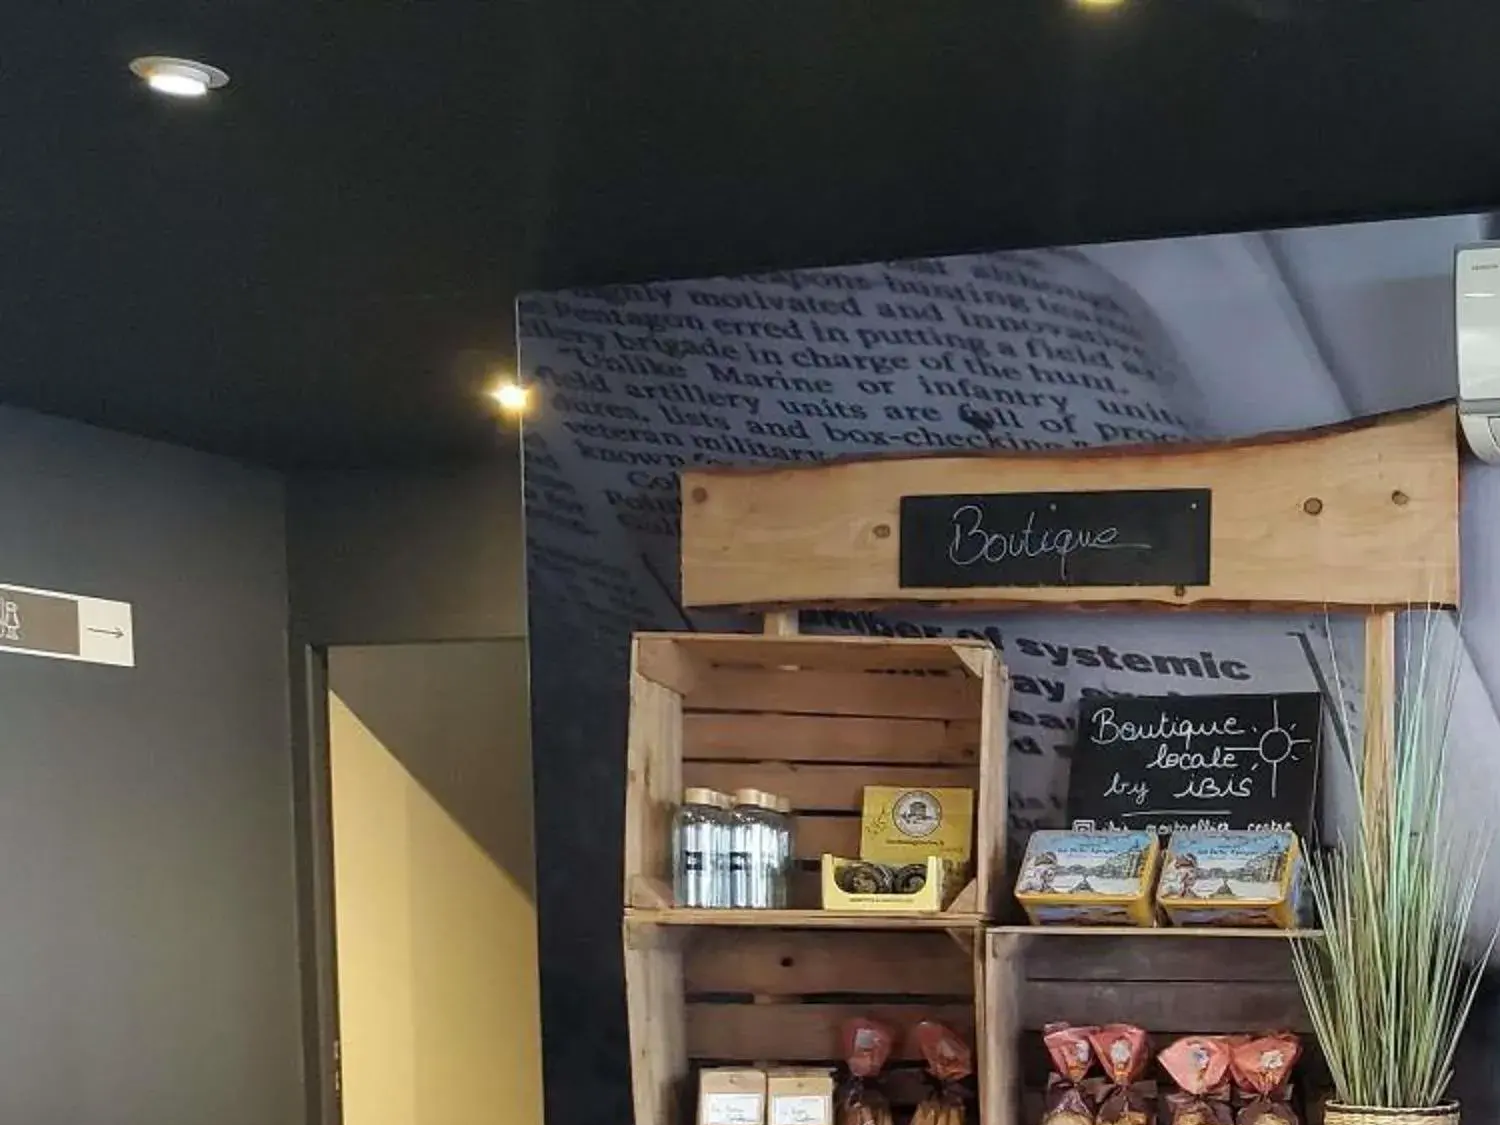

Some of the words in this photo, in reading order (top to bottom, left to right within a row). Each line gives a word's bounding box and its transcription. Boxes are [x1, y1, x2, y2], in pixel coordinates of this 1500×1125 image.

[687, 286, 863, 317] motivated
[876, 300, 944, 323] and
[712, 317, 805, 342] erred
[809, 319, 849, 343] in
[858, 327, 987, 360] putting
[745, 344, 783, 367] in
[791, 347, 910, 376] charge
[920, 351, 956, 374] of
[963, 355, 1022, 383] the
[624, 382, 761, 414] artillery
[776, 398, 868, 422] units
[884, 403, 941, 422] are
[1040, 416, 1080, 434] of
[705, 360, 834, 394] Marine
[857, 378, 896, 396] or
[918, 374, 1069, 414] infantry
[745, 419, 811, 440] and
[948, 504, 1142, 580] Boutique
[1015, 635, 1251, 682] systemic
[1091, 706, 1247, 749] Boutique
[1145, 743, 1239, 770] locale
[1104, 771, 1151, 805] by
